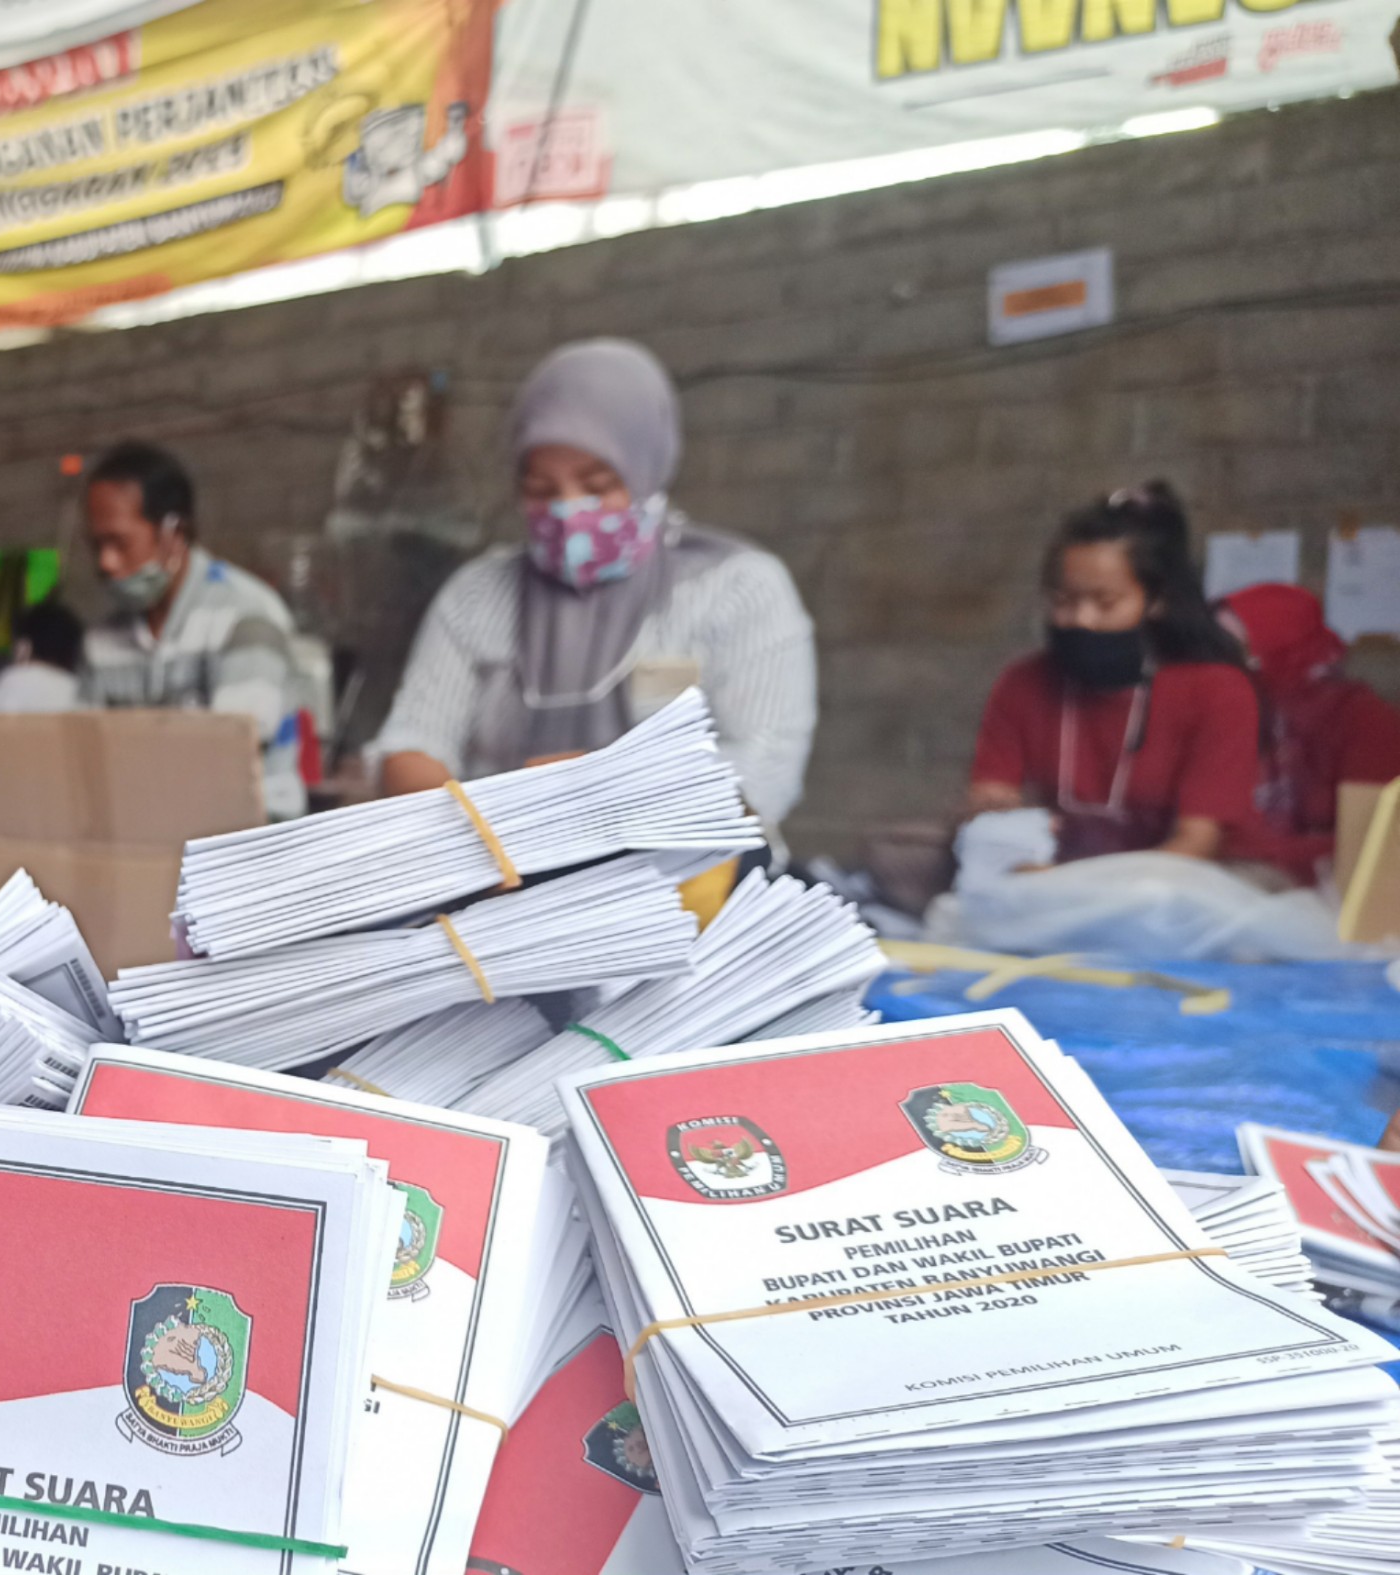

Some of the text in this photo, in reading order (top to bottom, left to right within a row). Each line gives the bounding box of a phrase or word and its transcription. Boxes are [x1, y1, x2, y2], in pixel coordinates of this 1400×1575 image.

[775, 1197, 1019, 1243] SURAT SUARA
[762, 1233, 1083, 1291] BUPATI DAN WAKIL BUPATI
[843, 1229, 977, 1260] PEMILIHAN
[808, 1271, 1090, 1321] PROVINSI JAWA TIMUR
[885, 1294, 1038, 1324] TAHUN 2020
[905, 1343, 1182, 1392] KOMISI PEMILIHAN UMUM
[146, 1433, 177, 1452] BHAKTI
[179, 1442, 208, 1453] PRAJA
[24, 1472, 156, 1520] SUARA
